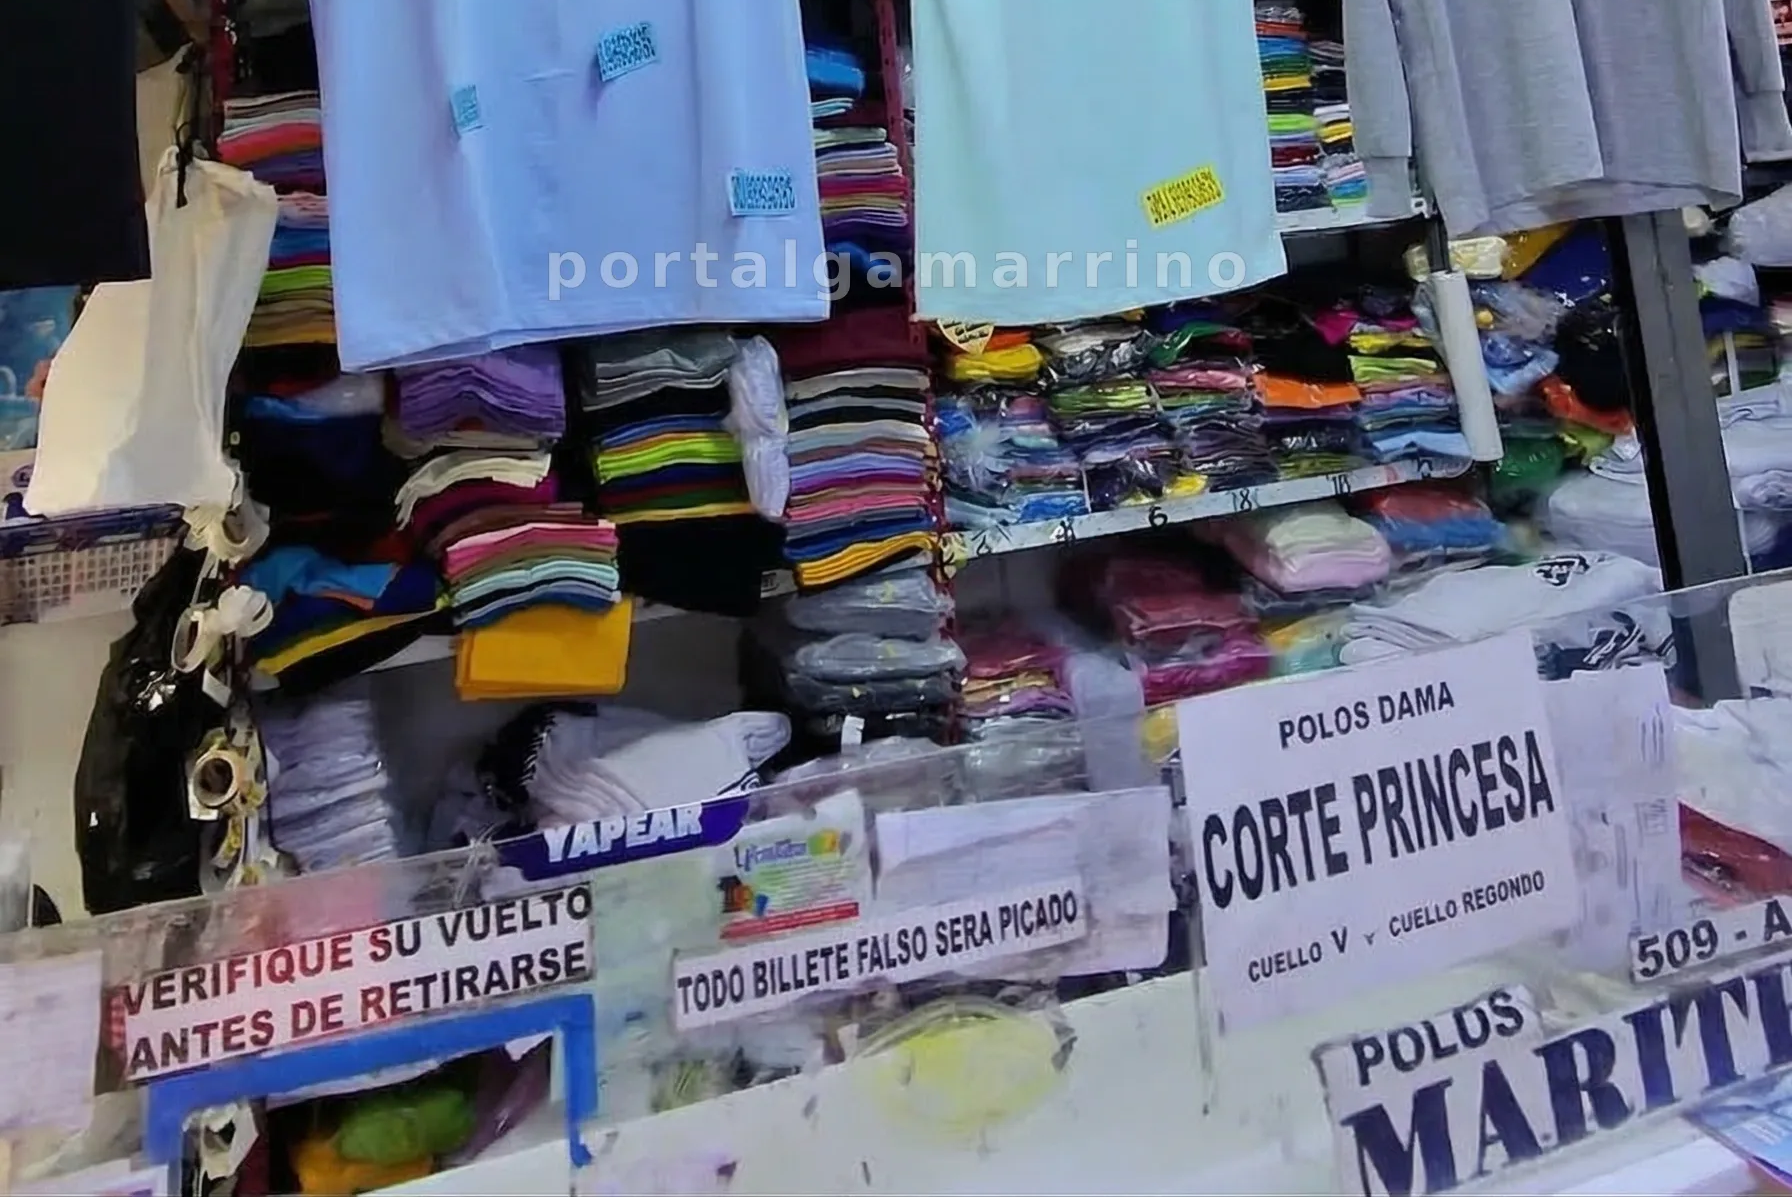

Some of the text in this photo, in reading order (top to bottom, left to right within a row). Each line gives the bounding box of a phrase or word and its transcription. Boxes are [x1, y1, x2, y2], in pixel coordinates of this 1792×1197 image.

[1148, 505, 1169, 530] 6
[1279, 681, 1455, 750] POLOS DAMA
[543, 803, 703, 863] YAPEAR
[1202, 730, 1555, 909] CORTE PRINCESA
[124, 886, 593, 1016] VERIFIQUE SU VUELTO
[677, 889, 1078, 1014] TODO BILLETE FALSO SERA PICADO
[1248, 941, 1322, 983] CUELLO
[1330, 926, 1348, 954] V
[1389, 899, 1457, 937] CUELLO
[1637, 918, 1719, 978] 509
[1763, 899, 1792, 943] A
[128, 941, 587, 1075] ANTES DE RETIRARSE
